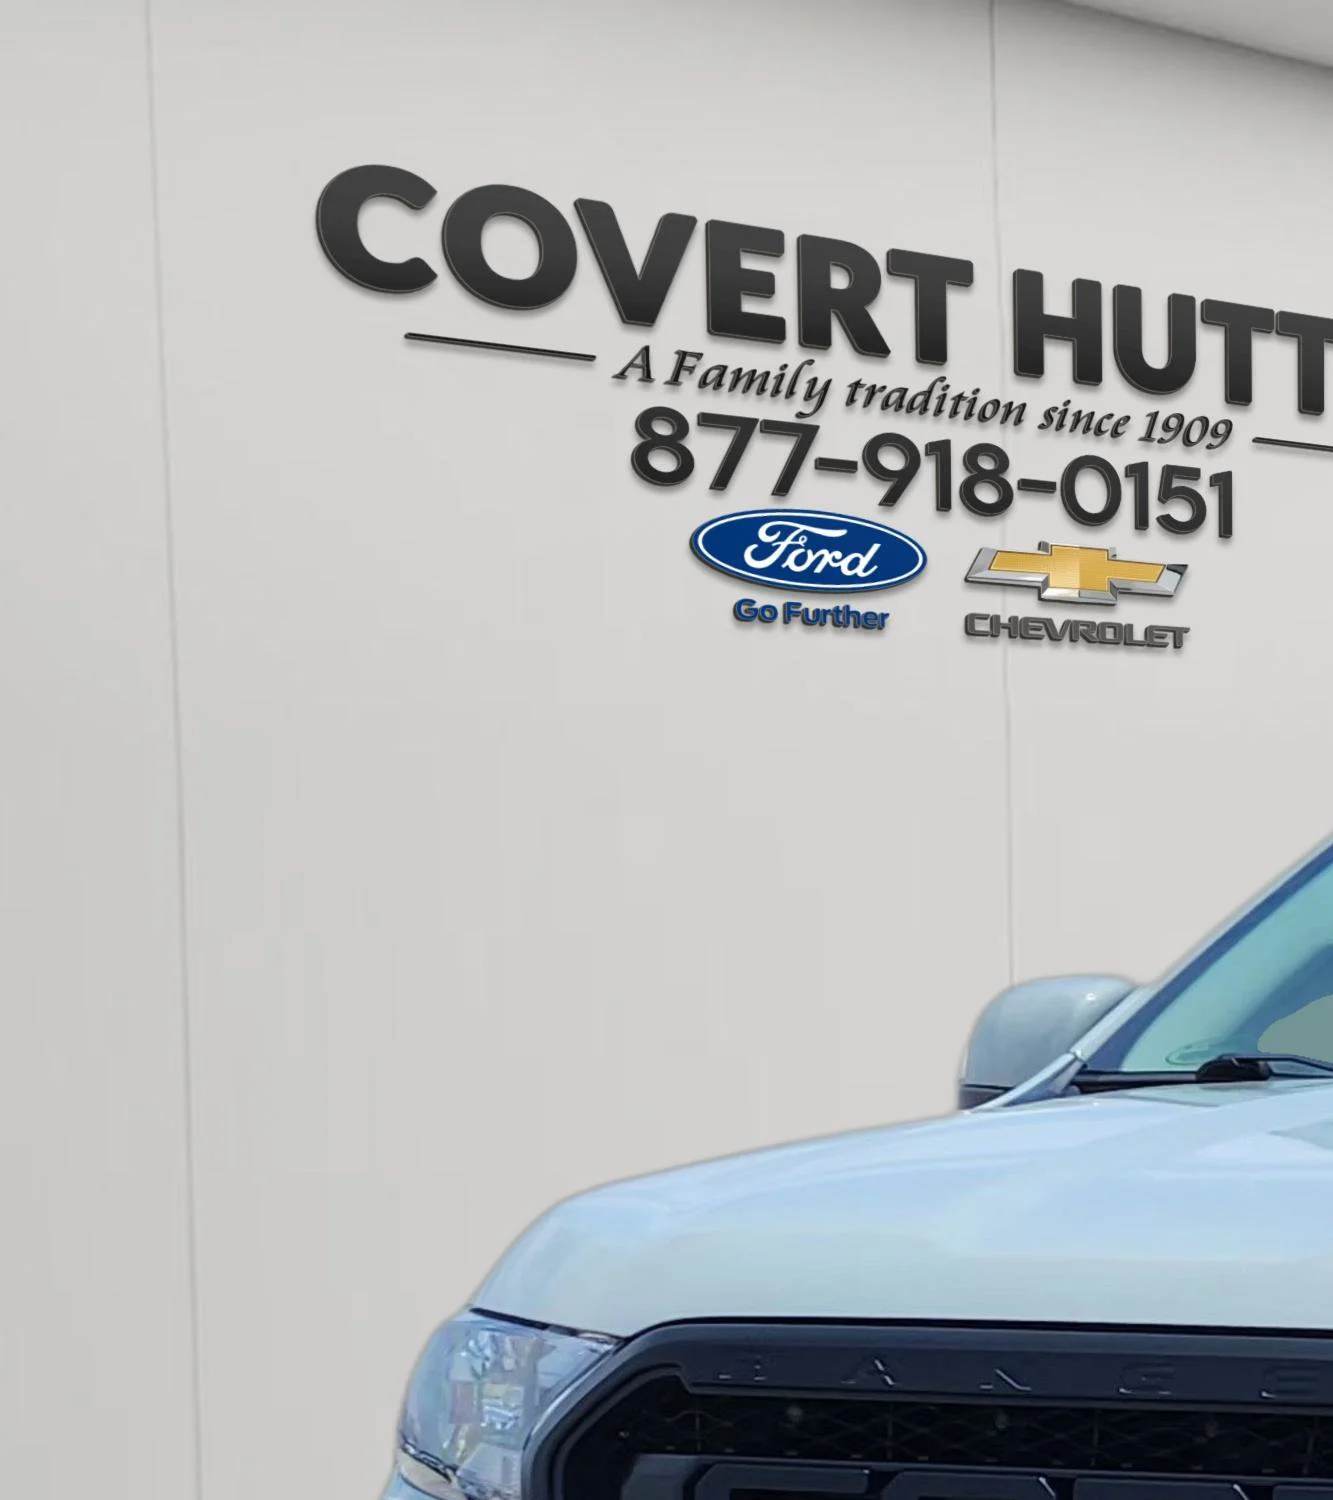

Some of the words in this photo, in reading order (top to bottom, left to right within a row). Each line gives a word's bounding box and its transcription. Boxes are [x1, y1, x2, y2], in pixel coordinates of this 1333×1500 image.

[315, 164, 974, 367] COVERT
[611, 345, 655, 384] A
[663, 349, 833, 420] Family
[845, 375, 1027, 427] tradition
[1037, 403, 1131, 439] since
[1138, 410, 1234, 450] 1909
[630, 406, 1233, 540] 877-918-0151
[742, 519, 882, 581] Ford
[732, 598, 779, 624] Go
[782, 601, 890, 631] Further
[964, 612, 1190, 650] CHEVROLET
